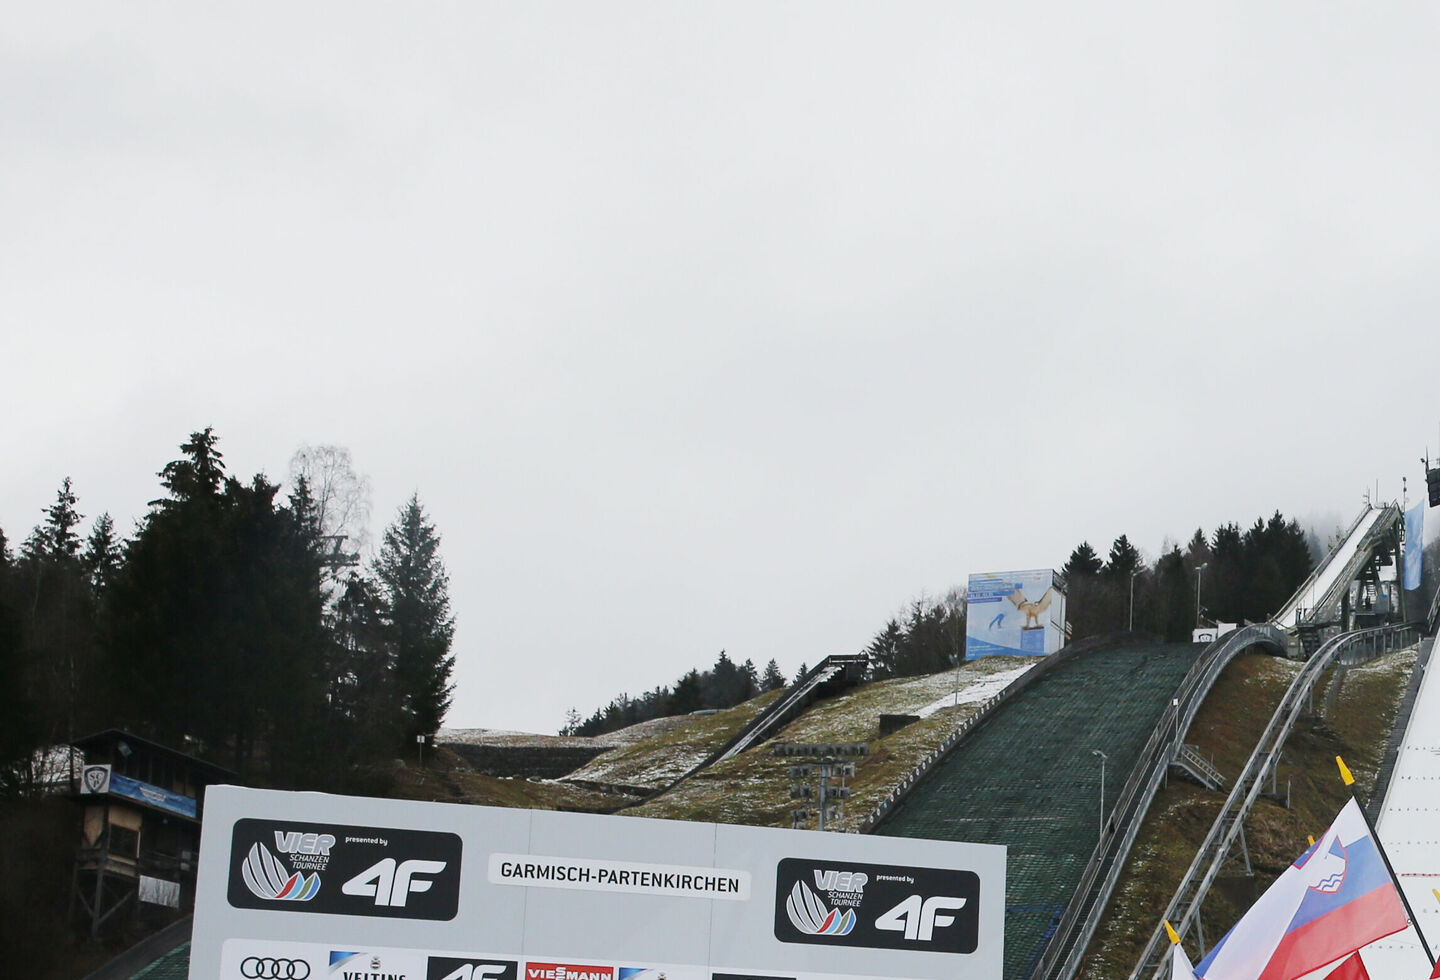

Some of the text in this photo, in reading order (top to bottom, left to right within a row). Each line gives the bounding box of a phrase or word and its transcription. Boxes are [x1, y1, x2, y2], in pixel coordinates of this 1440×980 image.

[274, 830, 336, 856] VIER
[345, 835, 388, 846] presented by
[289, 853, 330, 864] SCHANZEN
[342, 857, 447, 908] 4F
[500, 861, 740, 894] GARMISCH-PARTENKIRCHEN
[813, 869, 869, 893] VIER
[876, 874, 915, 884] presented by
[827, 891, 864, 901] SCHANZEN
[874, 894, 967, 942] 4F
